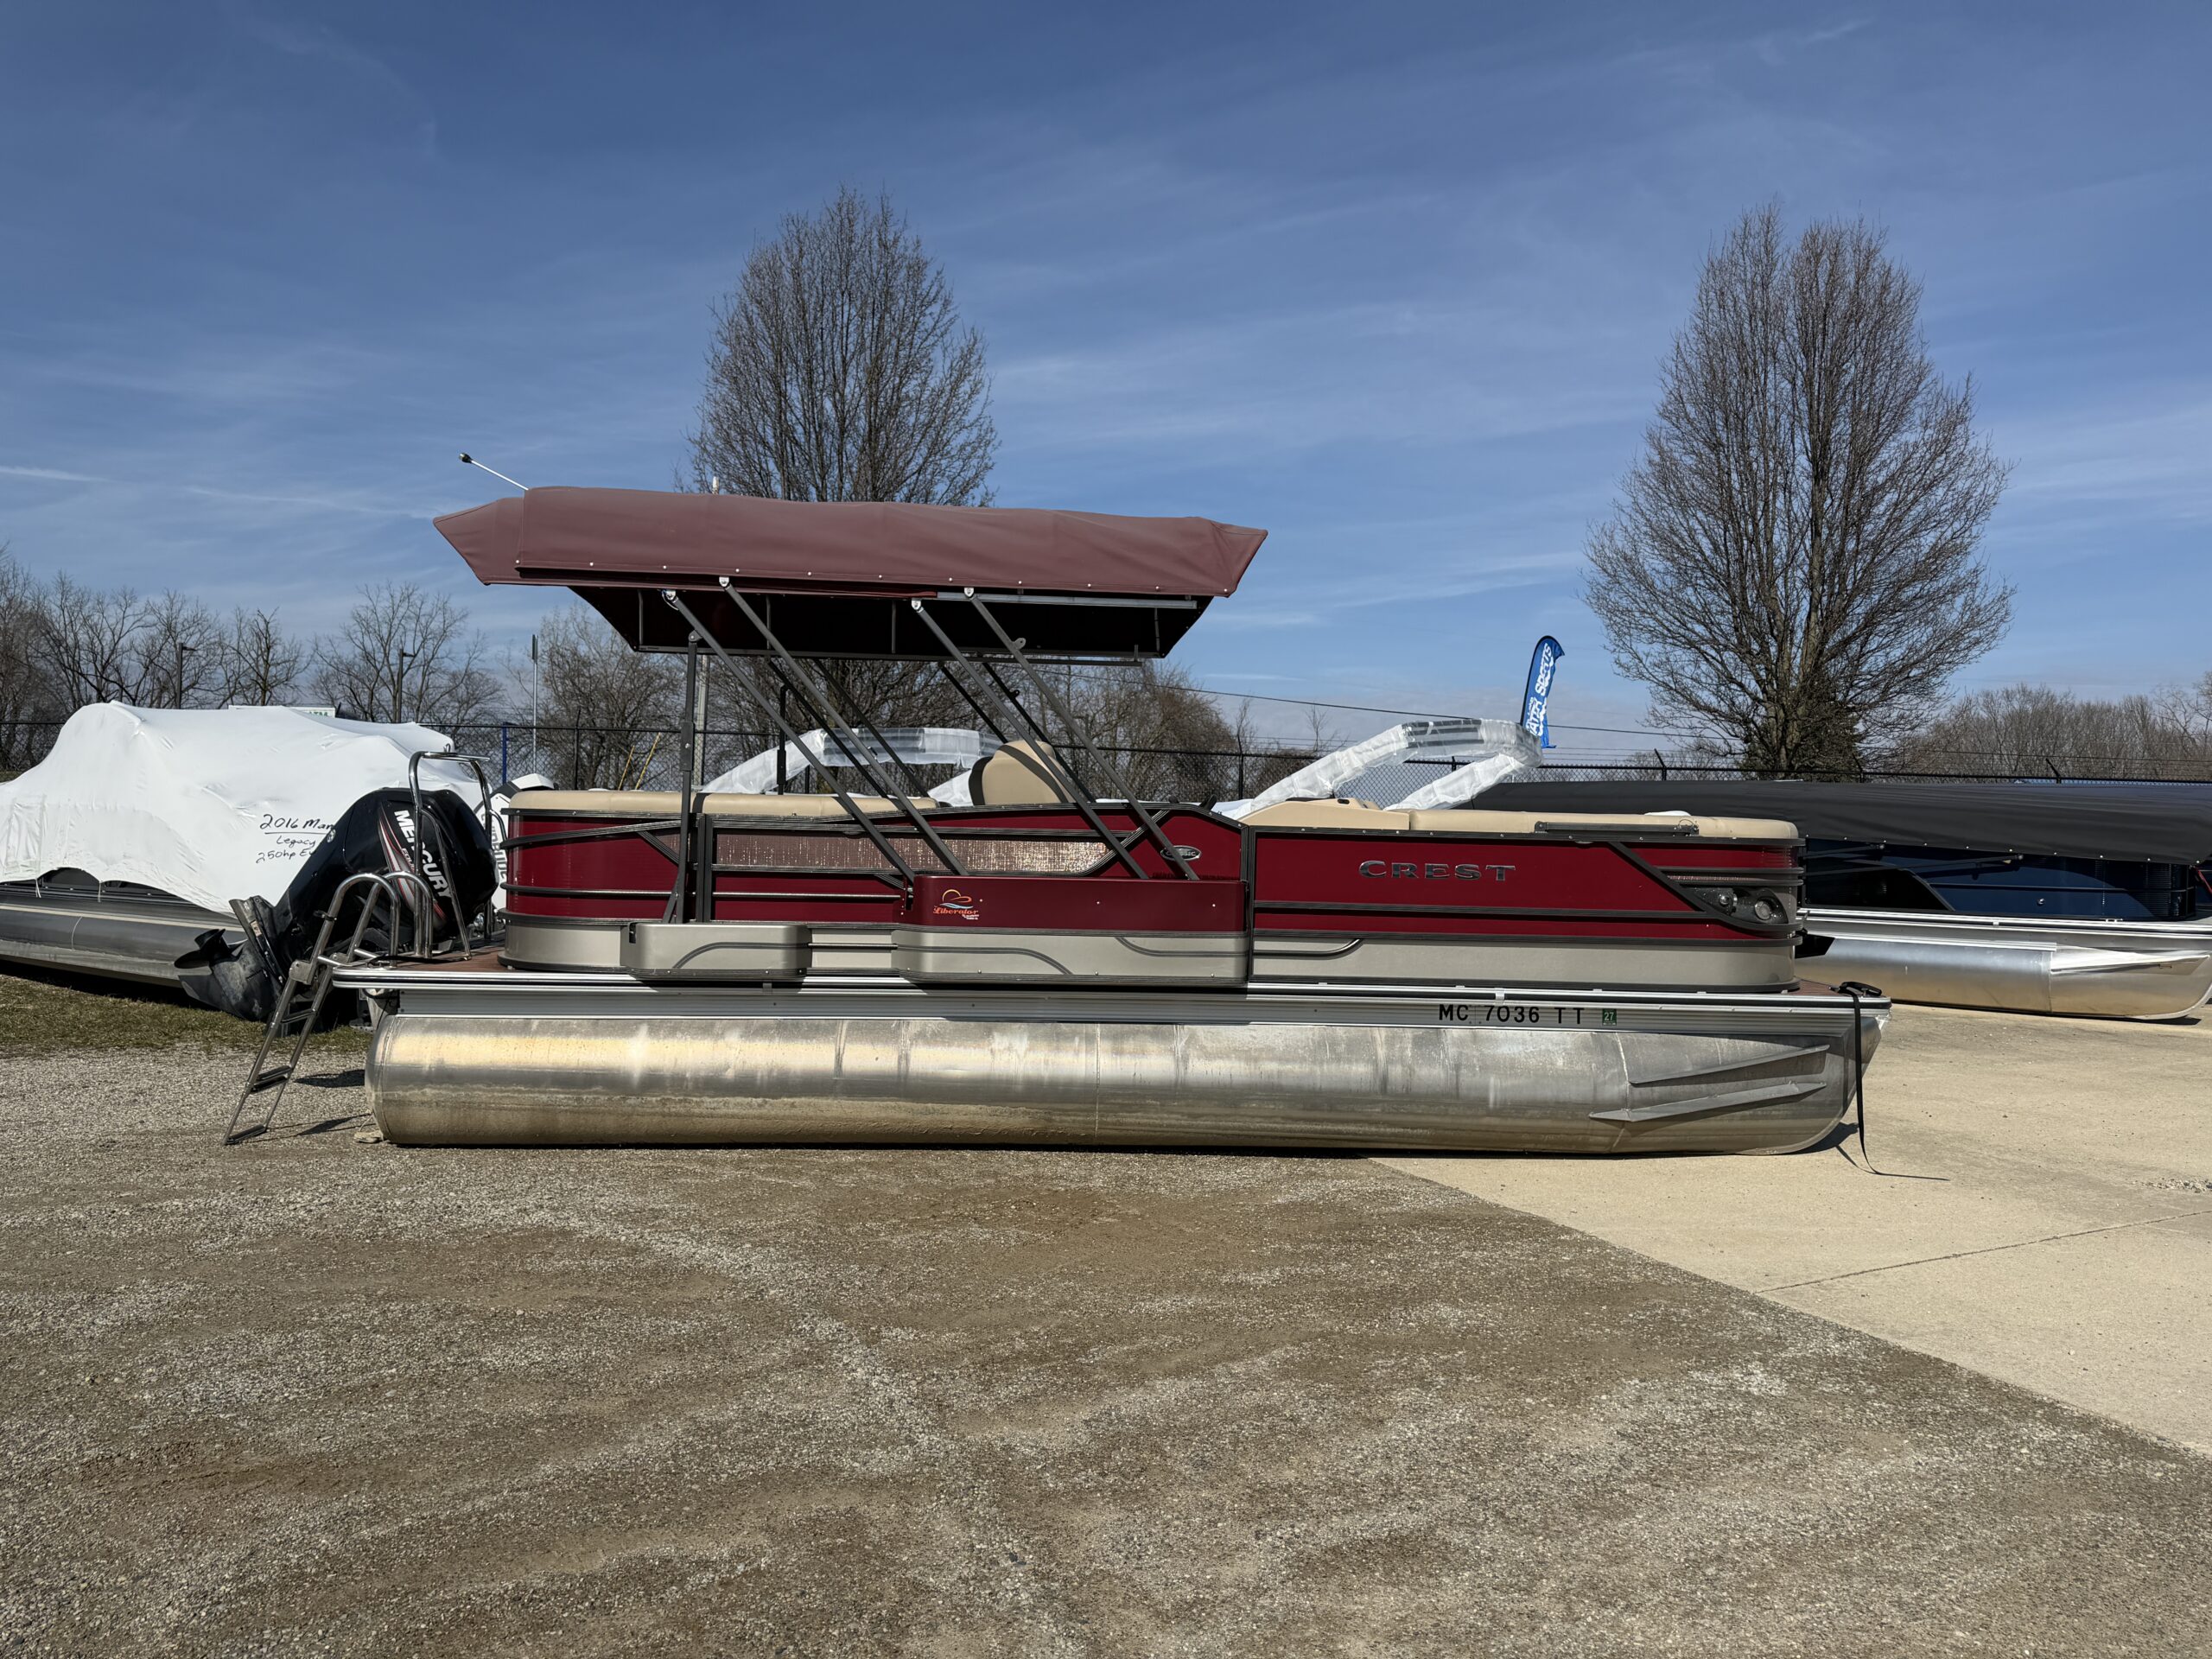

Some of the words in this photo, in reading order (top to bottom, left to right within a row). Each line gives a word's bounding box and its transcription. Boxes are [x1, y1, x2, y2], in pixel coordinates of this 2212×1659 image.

[260, 814, 298, 830] 2016
[276, 835, 316, 848] Legacy
[256, 849, 296, 863] 250hp
[1358, 860, 1516, 881] CREST
[933, 906, 978, 915] Liberator
[1439, 1004, 1469, 1021] MC
[1484, 1005, 1541, 1024] 7036
[1604, 1011, 1614, 1021] 27
